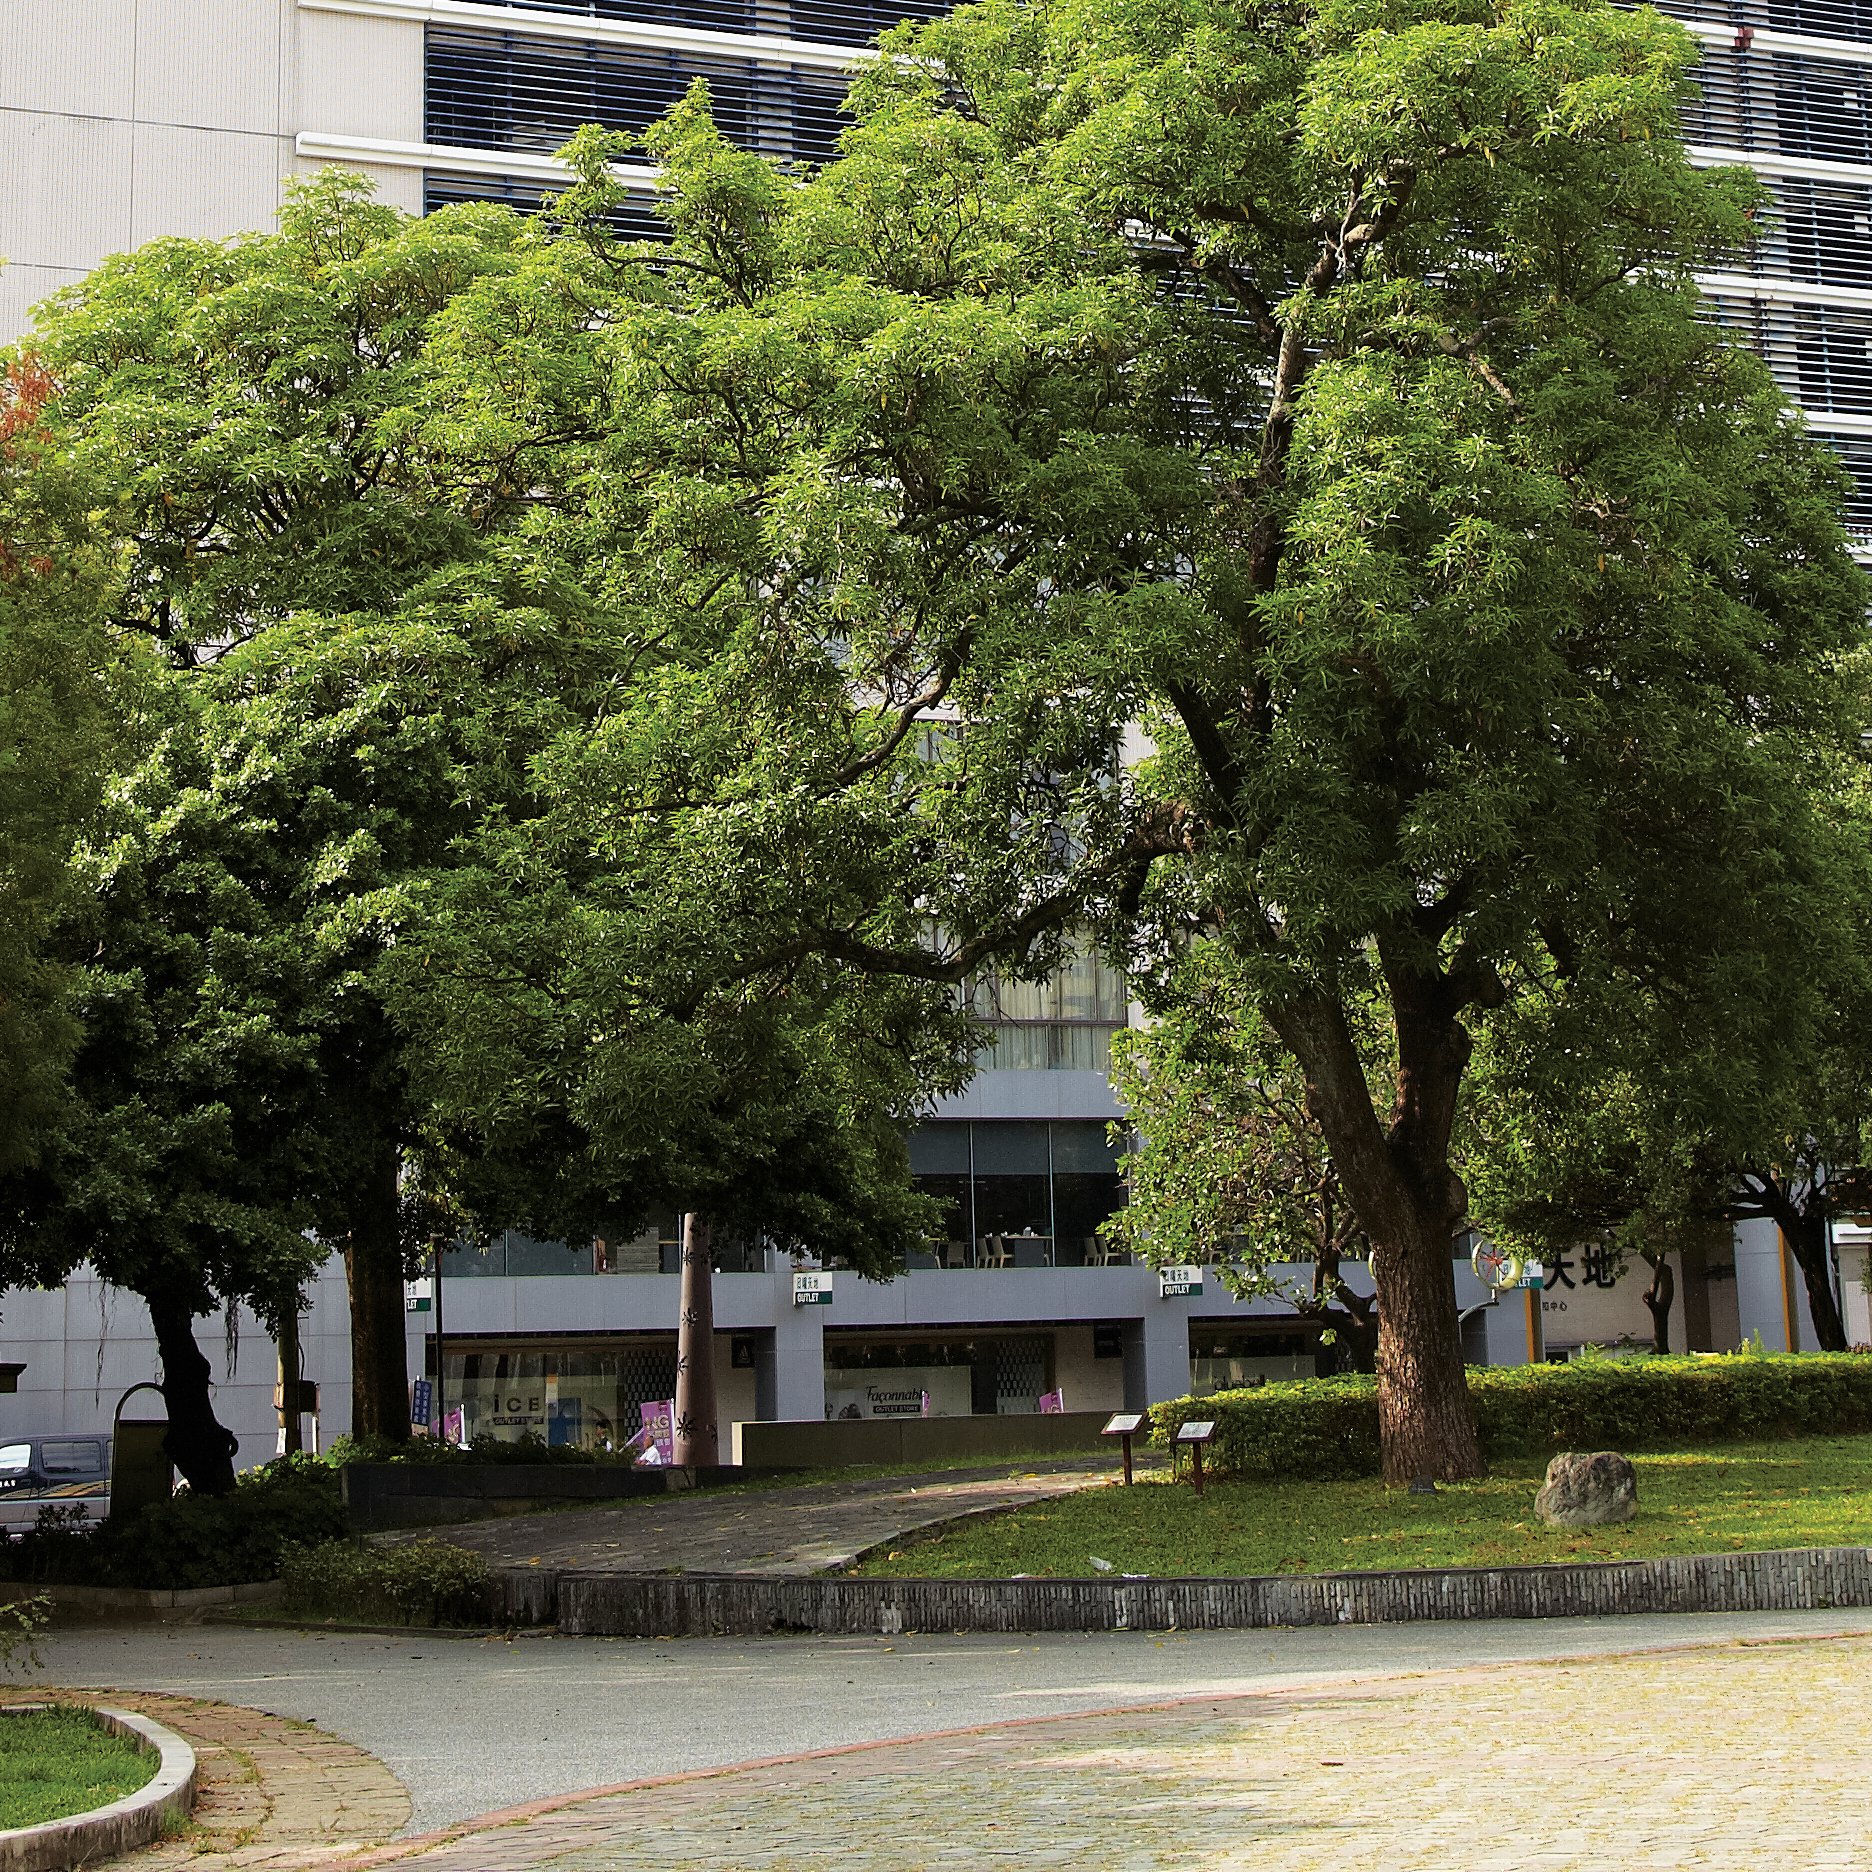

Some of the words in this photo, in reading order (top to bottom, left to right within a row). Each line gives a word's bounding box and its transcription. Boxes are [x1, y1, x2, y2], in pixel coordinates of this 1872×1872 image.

[1165, 1285, 1189, 1295] OUTLET
[797, 1293, 819, 1303] OUTLET
[866, 1385, 924, 1403] Façonnabl
